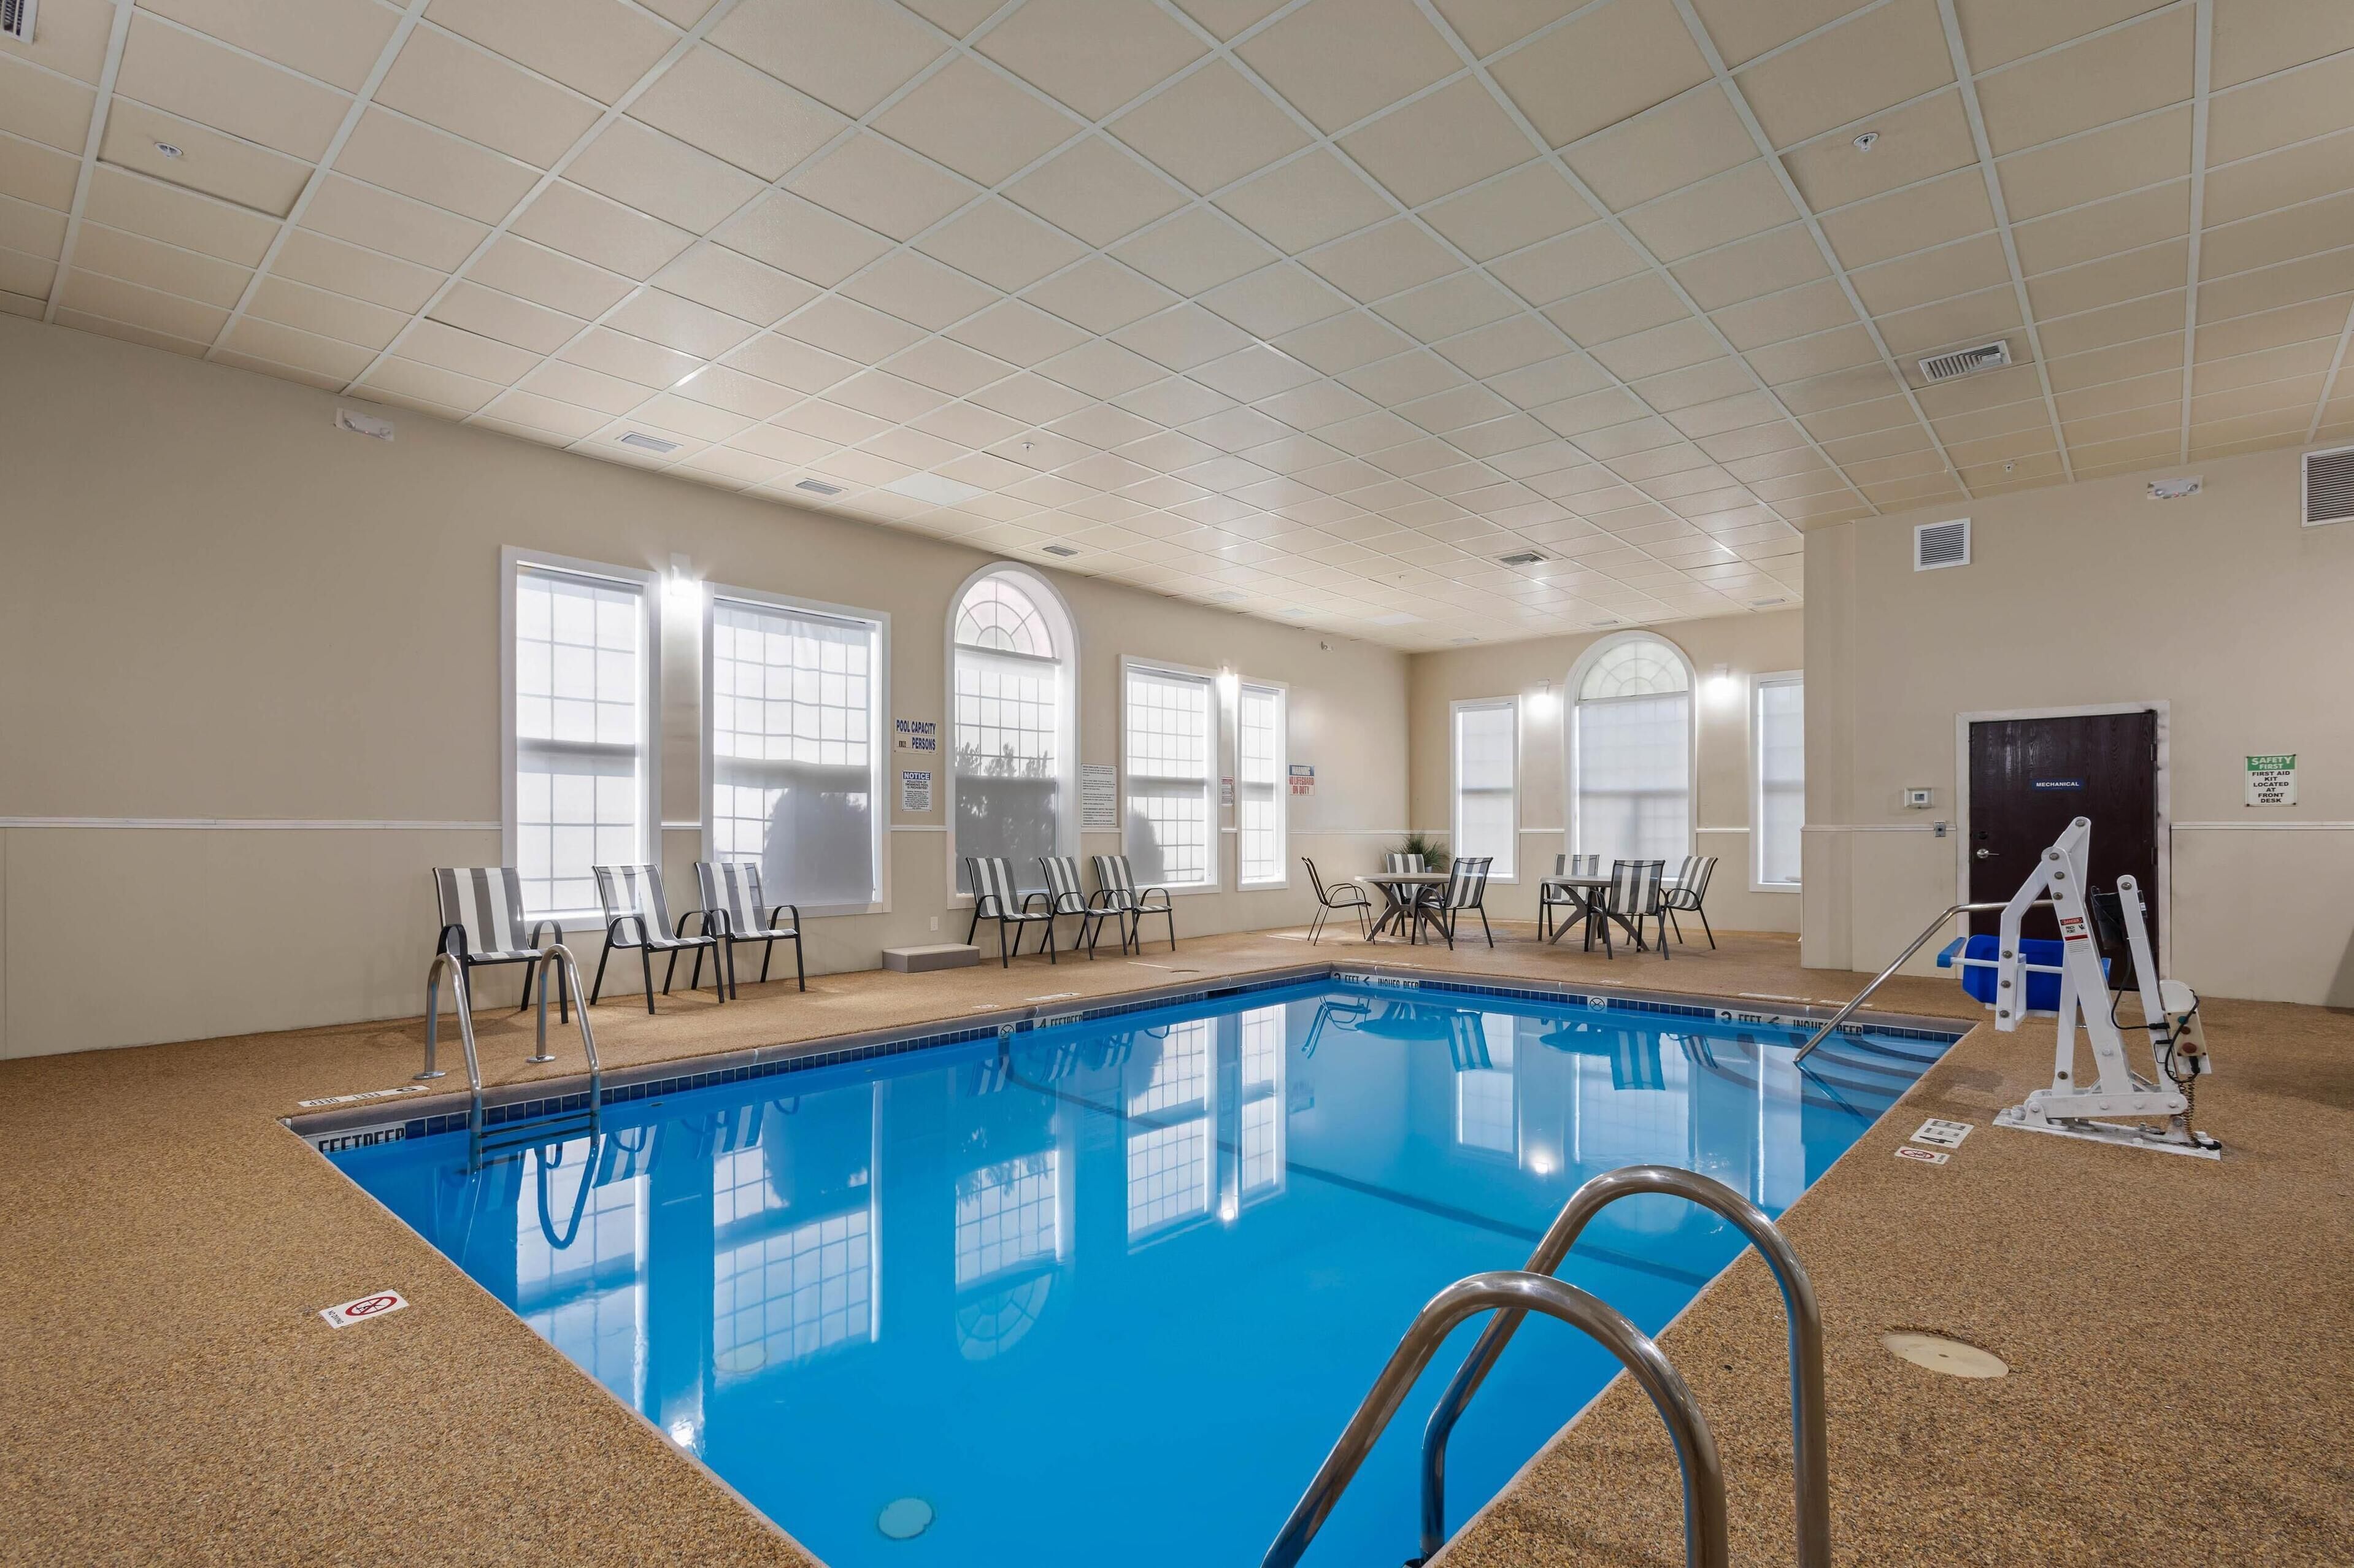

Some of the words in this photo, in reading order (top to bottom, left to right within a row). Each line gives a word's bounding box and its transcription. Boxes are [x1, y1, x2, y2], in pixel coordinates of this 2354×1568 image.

[896, 720, 910, 732] POOL
[912, 721, 936, 735] CAPACITY
[912, 737, 936, 751] PERSONS
[2251, 756, 2293, 765] SAFETY
[1294, 777, 1314, 785] LIFEGUARD
